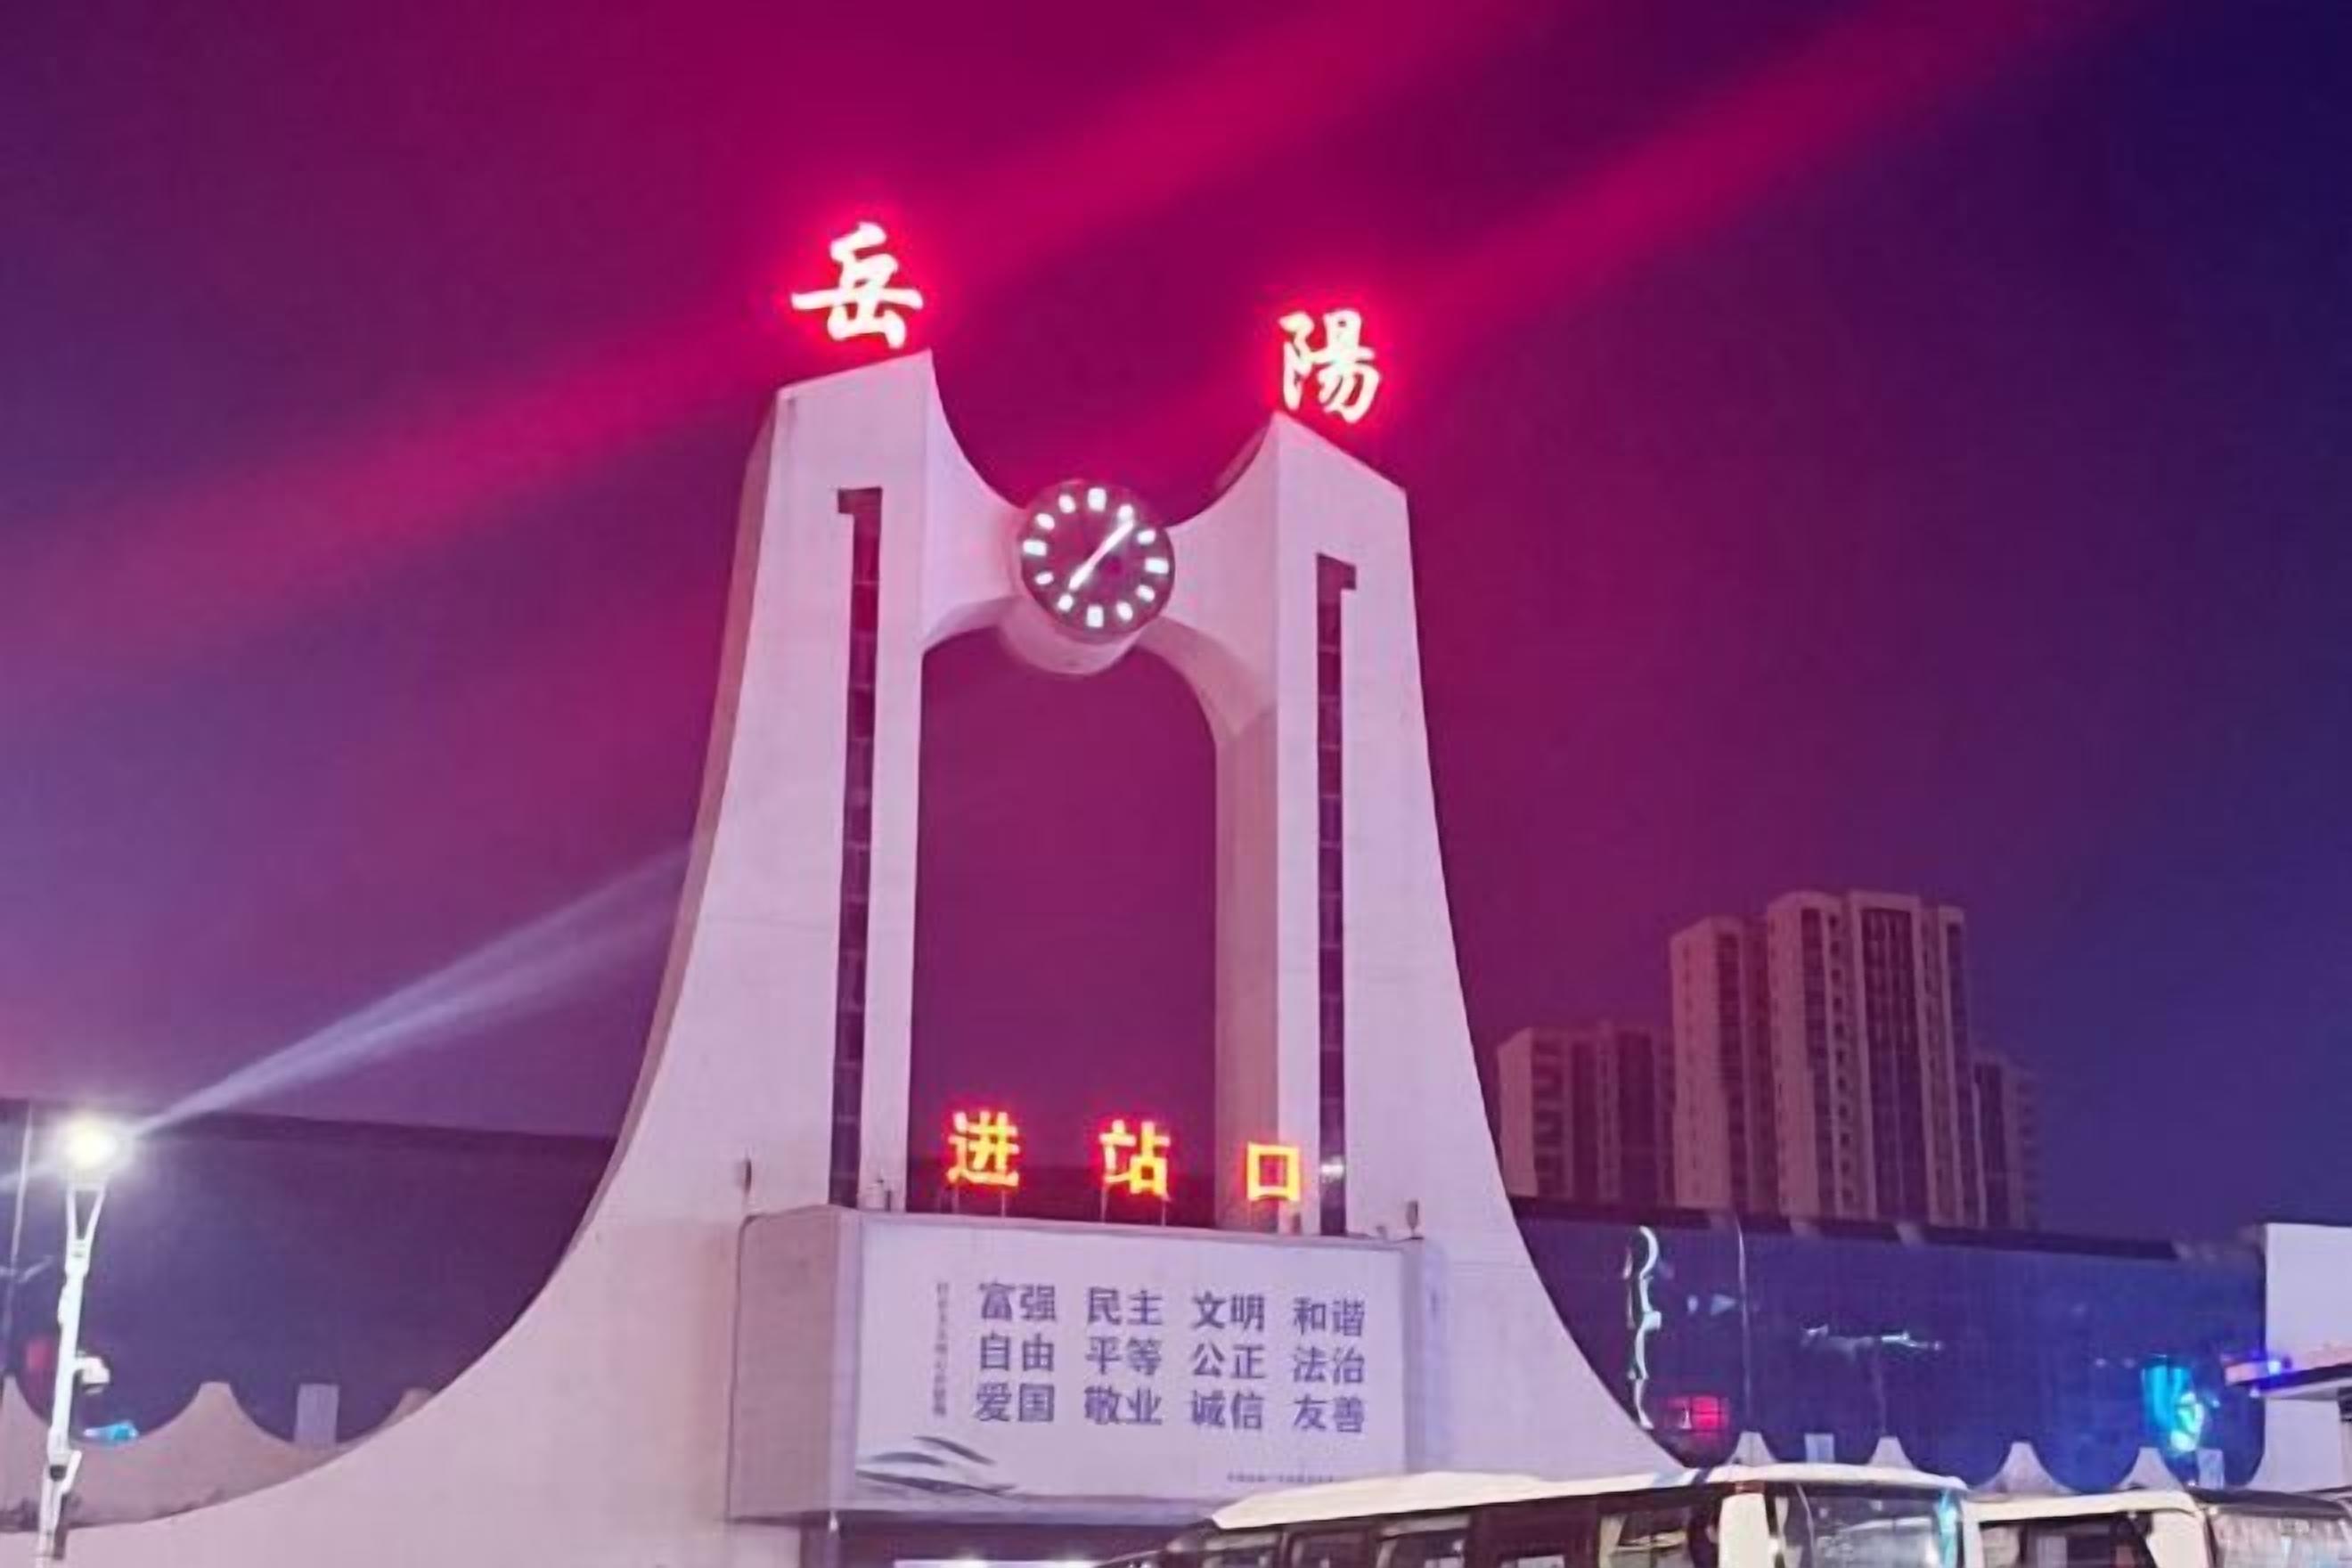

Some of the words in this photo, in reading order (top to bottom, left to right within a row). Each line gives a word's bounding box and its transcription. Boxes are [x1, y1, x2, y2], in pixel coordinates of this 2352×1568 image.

[790, 222, 925, 348] 岳
[1278, 307, 1381, 424] 陽
[947, 1110, 1302, 1203] 进站口
[978, 1281, 1056, 1322] 富强
[1087, 1286, 1164, 1326] 民主
[1191, 1291, 1265, 1332] 文明
[1293, 1297, 1366, 1337] 和谐
[980, 1330, 1055, 1372] 自由
[1084, 1335, 1163, 1376] 平等
[1191, 1343, 1266, 1379] 公正
[1293, 1346, 1366, 1385] 法治
[976, 1383, 1055, 1423] 爱国
[1083, 1385, 1164, 1425] 敬业
[1191, 1390, 1265, 1430] 诚信
[1293, 1393, 1365, 1433] 友善
